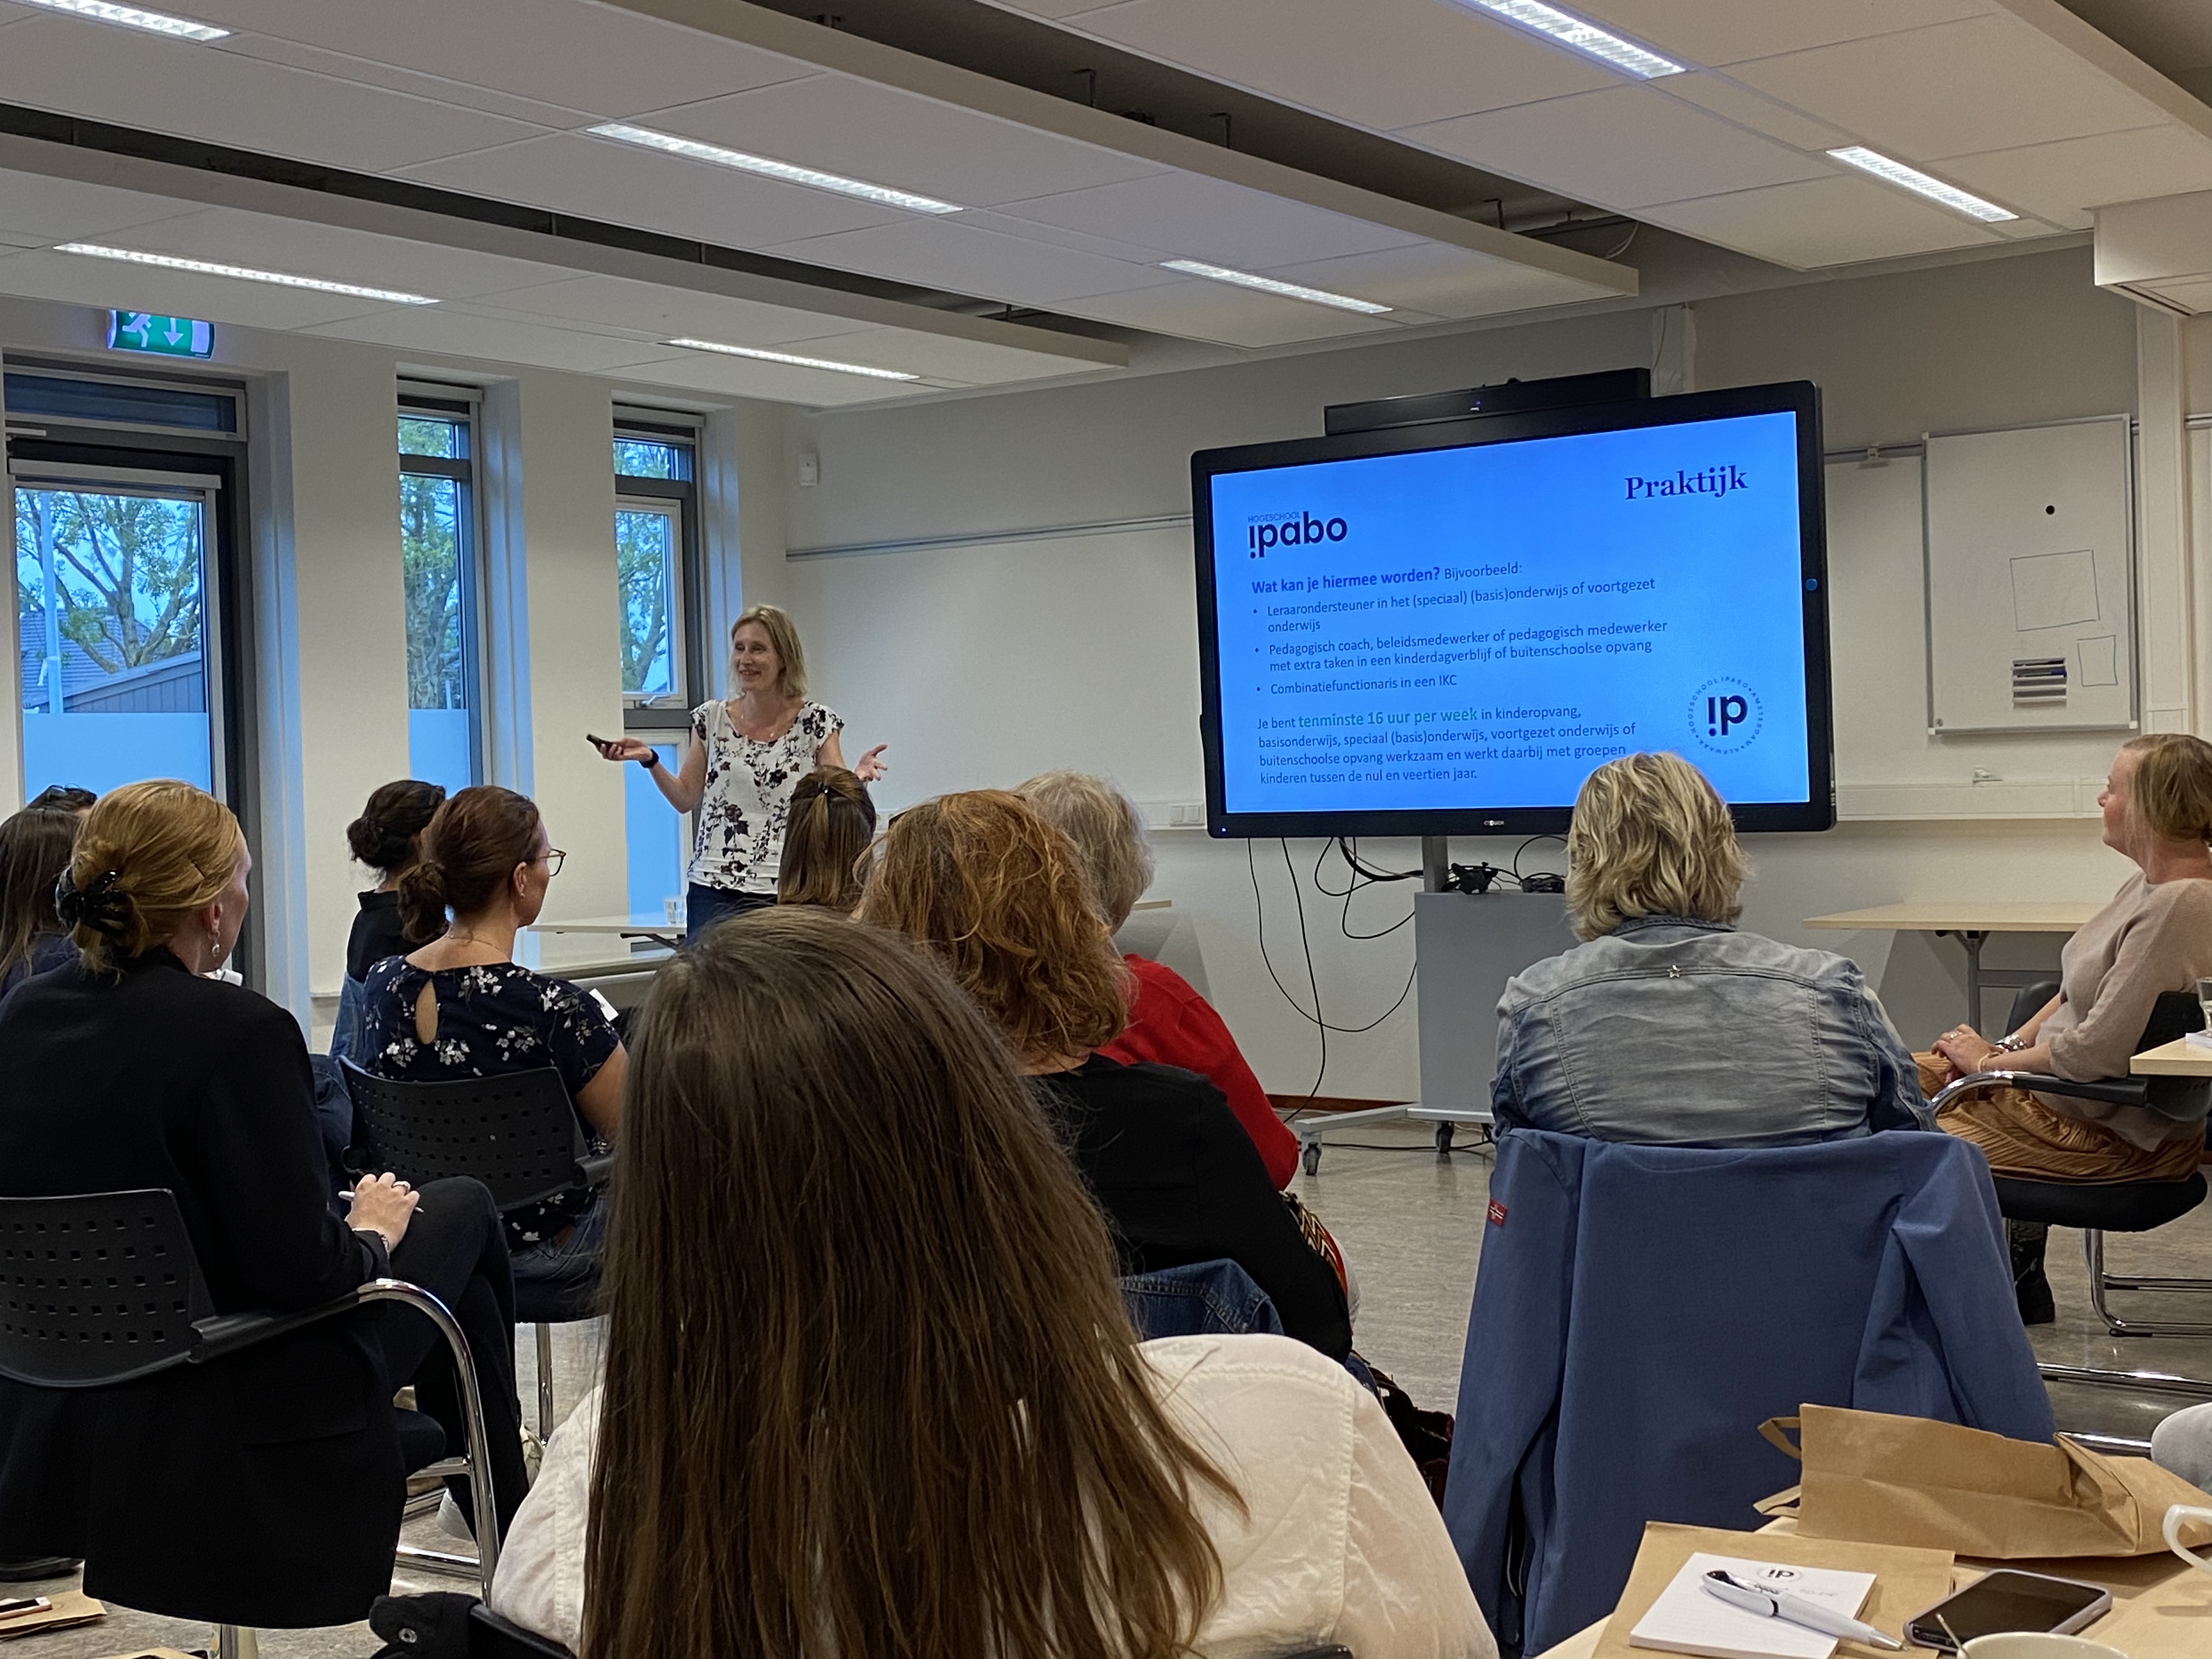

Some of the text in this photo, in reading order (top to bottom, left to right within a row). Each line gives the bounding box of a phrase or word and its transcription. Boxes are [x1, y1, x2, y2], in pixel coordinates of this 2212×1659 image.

[1624, 465, 1749, 500] Praktijk
[1248, 511, 1301, 523] HOGESCHOOL
[1252, 562, 1522, 594] Wat kan je hiermee worden? Bijvoorbeeld:
[1268, 578, 1655, 617] Leraarondersteuner in het (speciaal) (basis)onderwijs of voortgezet
[1268, 619, 1321, 633] onderwijs
[1269, 620, 1667, 657] Pedagogisch coach, beleidsmedewerker of pedagogisch medewerker
[1270, 640, 1652, 672] met extra taken in een kinderdagverblijf of buitenschoolse opvang
[1271, 674, 1458, 695] Combinatiefunctionaris in een IKC
[1257, 707, 1581, 729] Je bent tenminste 16 uur per week in kinderopvang,
[1259, 723, 1636, 748] basisonderwijs, speciaal (basis)onderwijs, voortgezet onderwijs of
[1260, 745, 1626, 766] buitenschoolse opvang werkzaam en werkt daarbij met groepen
[1261, 769, 1477, 784] kinderen tussen de nul en veertien jaar.
